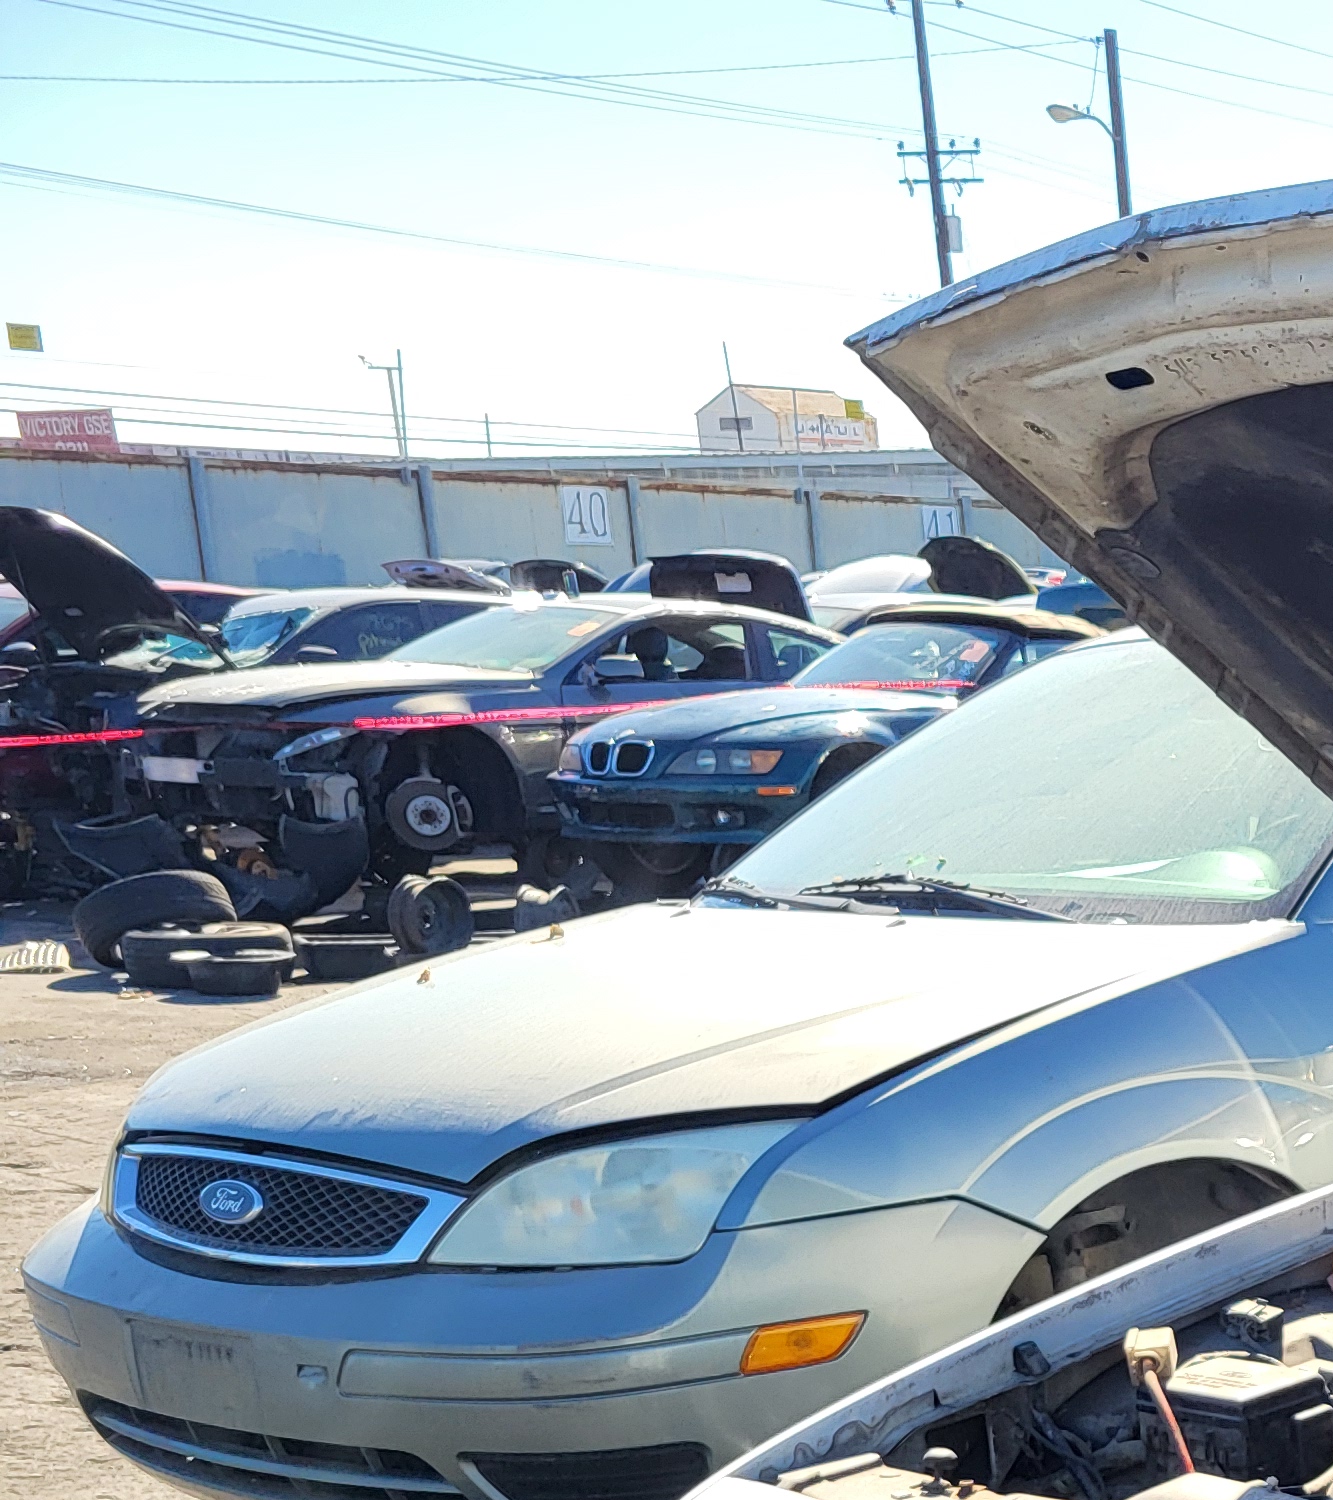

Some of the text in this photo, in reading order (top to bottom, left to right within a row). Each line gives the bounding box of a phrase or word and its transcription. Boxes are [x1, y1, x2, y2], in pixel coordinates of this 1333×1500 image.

[20, 414, 112, 437] VICTORY GSE
[567, 490, 608, 537] 40
[210, 1187, 245, 1213] Ford
